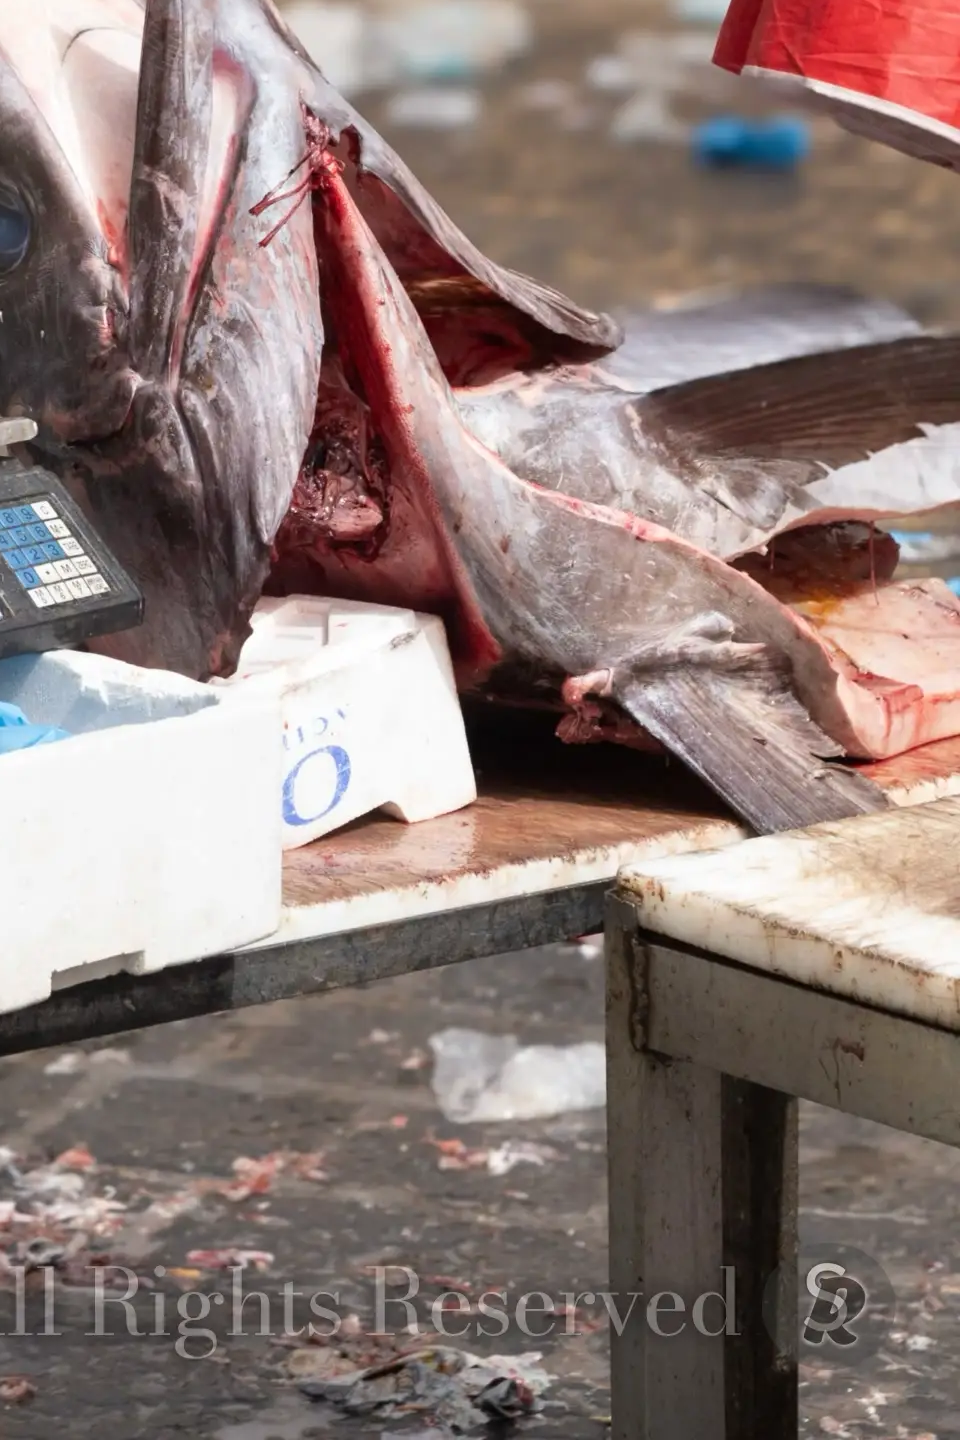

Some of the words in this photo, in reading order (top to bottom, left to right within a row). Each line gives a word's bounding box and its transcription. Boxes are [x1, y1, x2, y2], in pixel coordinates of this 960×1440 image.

[2, 512, 14, 524] 8
[35, 526, 46, 538] 6
[29, 549, 41, 561] 2
[48, 544, 59, 556] 3
[23, 571, 35, 584] 0
